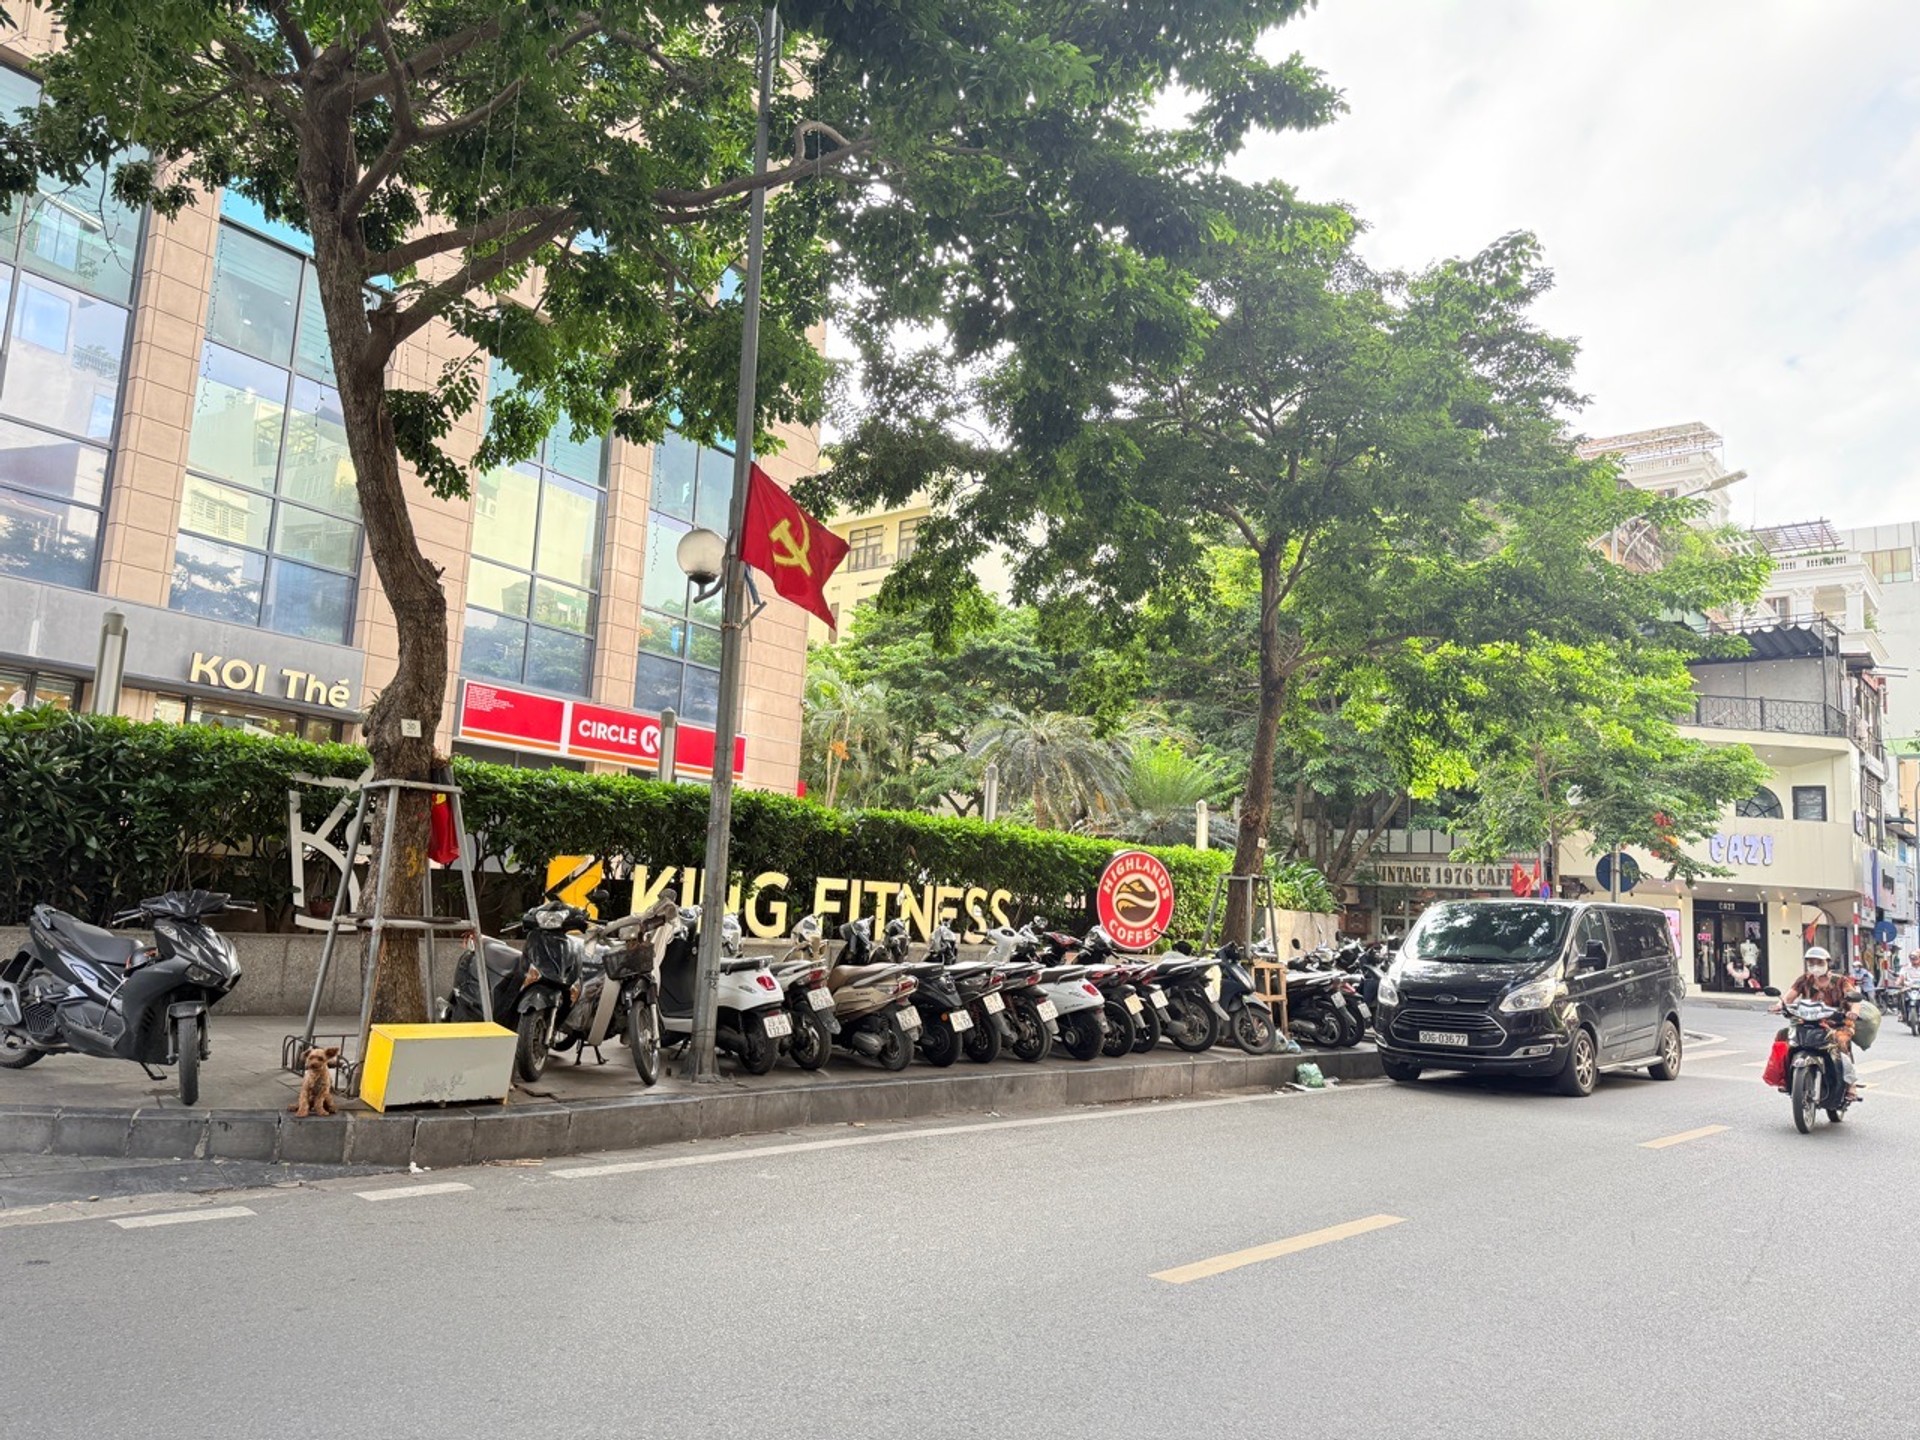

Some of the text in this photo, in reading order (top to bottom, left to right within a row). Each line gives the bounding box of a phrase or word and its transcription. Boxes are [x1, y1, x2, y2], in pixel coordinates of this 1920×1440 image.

[190, 652, 351, 709] KOI Thé
[578, 719, 660, 753] CIRCLE K
[1103, 858, 1170, 899] HIGHLANDS
[1375, 866, 1431, 884] VINTAGE
[1435, 867, 1473, 885] 1976
[813, 876, 1013, 945] FITNESS
[1108, 919, 1161, 943] COFFEE
